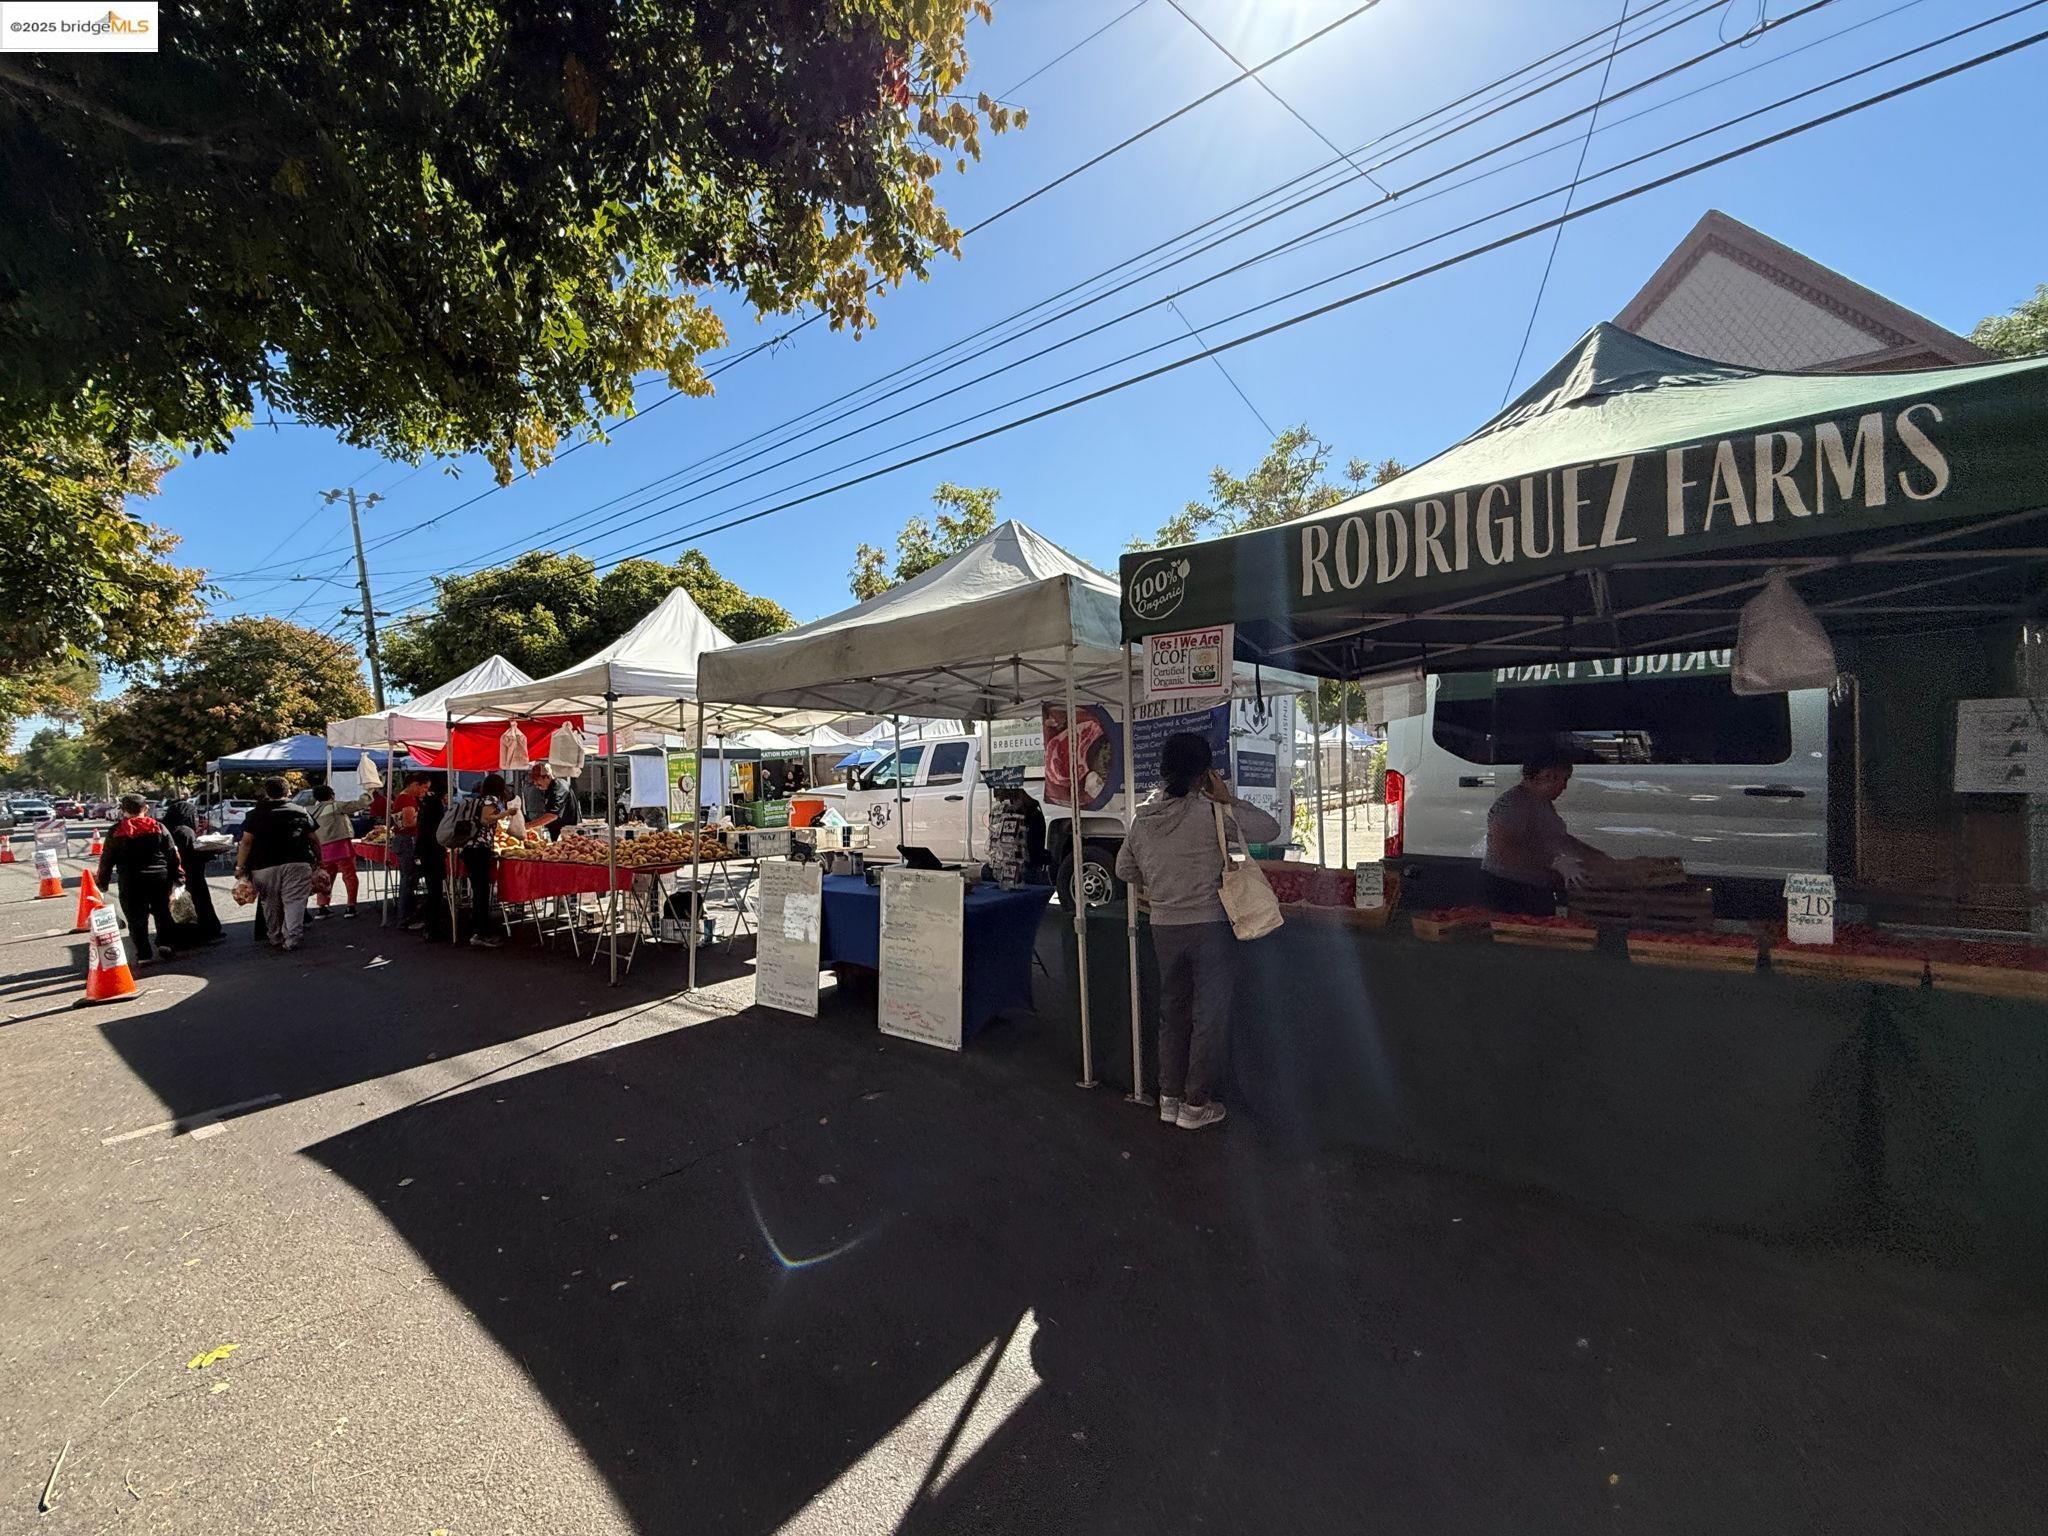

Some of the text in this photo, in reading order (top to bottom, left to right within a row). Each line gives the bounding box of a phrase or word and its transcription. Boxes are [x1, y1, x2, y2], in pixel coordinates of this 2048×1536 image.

[1301, 402, 1950, 597] RODRIGUEZ FARMS
[1134, 568, 1178, 603] 100%
[1138, 587, 1182, 613] Organic
[1153, 639, 1172, 651] Yes
[1180, 635, 1198, 648] We
[1199, 633, 1220, 646] Are
[1152, 648, 1188, 666] CCOF
[1153, 665, 1185, 677] Certified
[1193, 664, 1215, 672] CCOF
[1153, 675, 1185, 687] Organic
[1153, 720, 1174, 729] Owned
[1181, 713, 1211, 725] Operated
[781, 749, 799, 757] BOOTH
